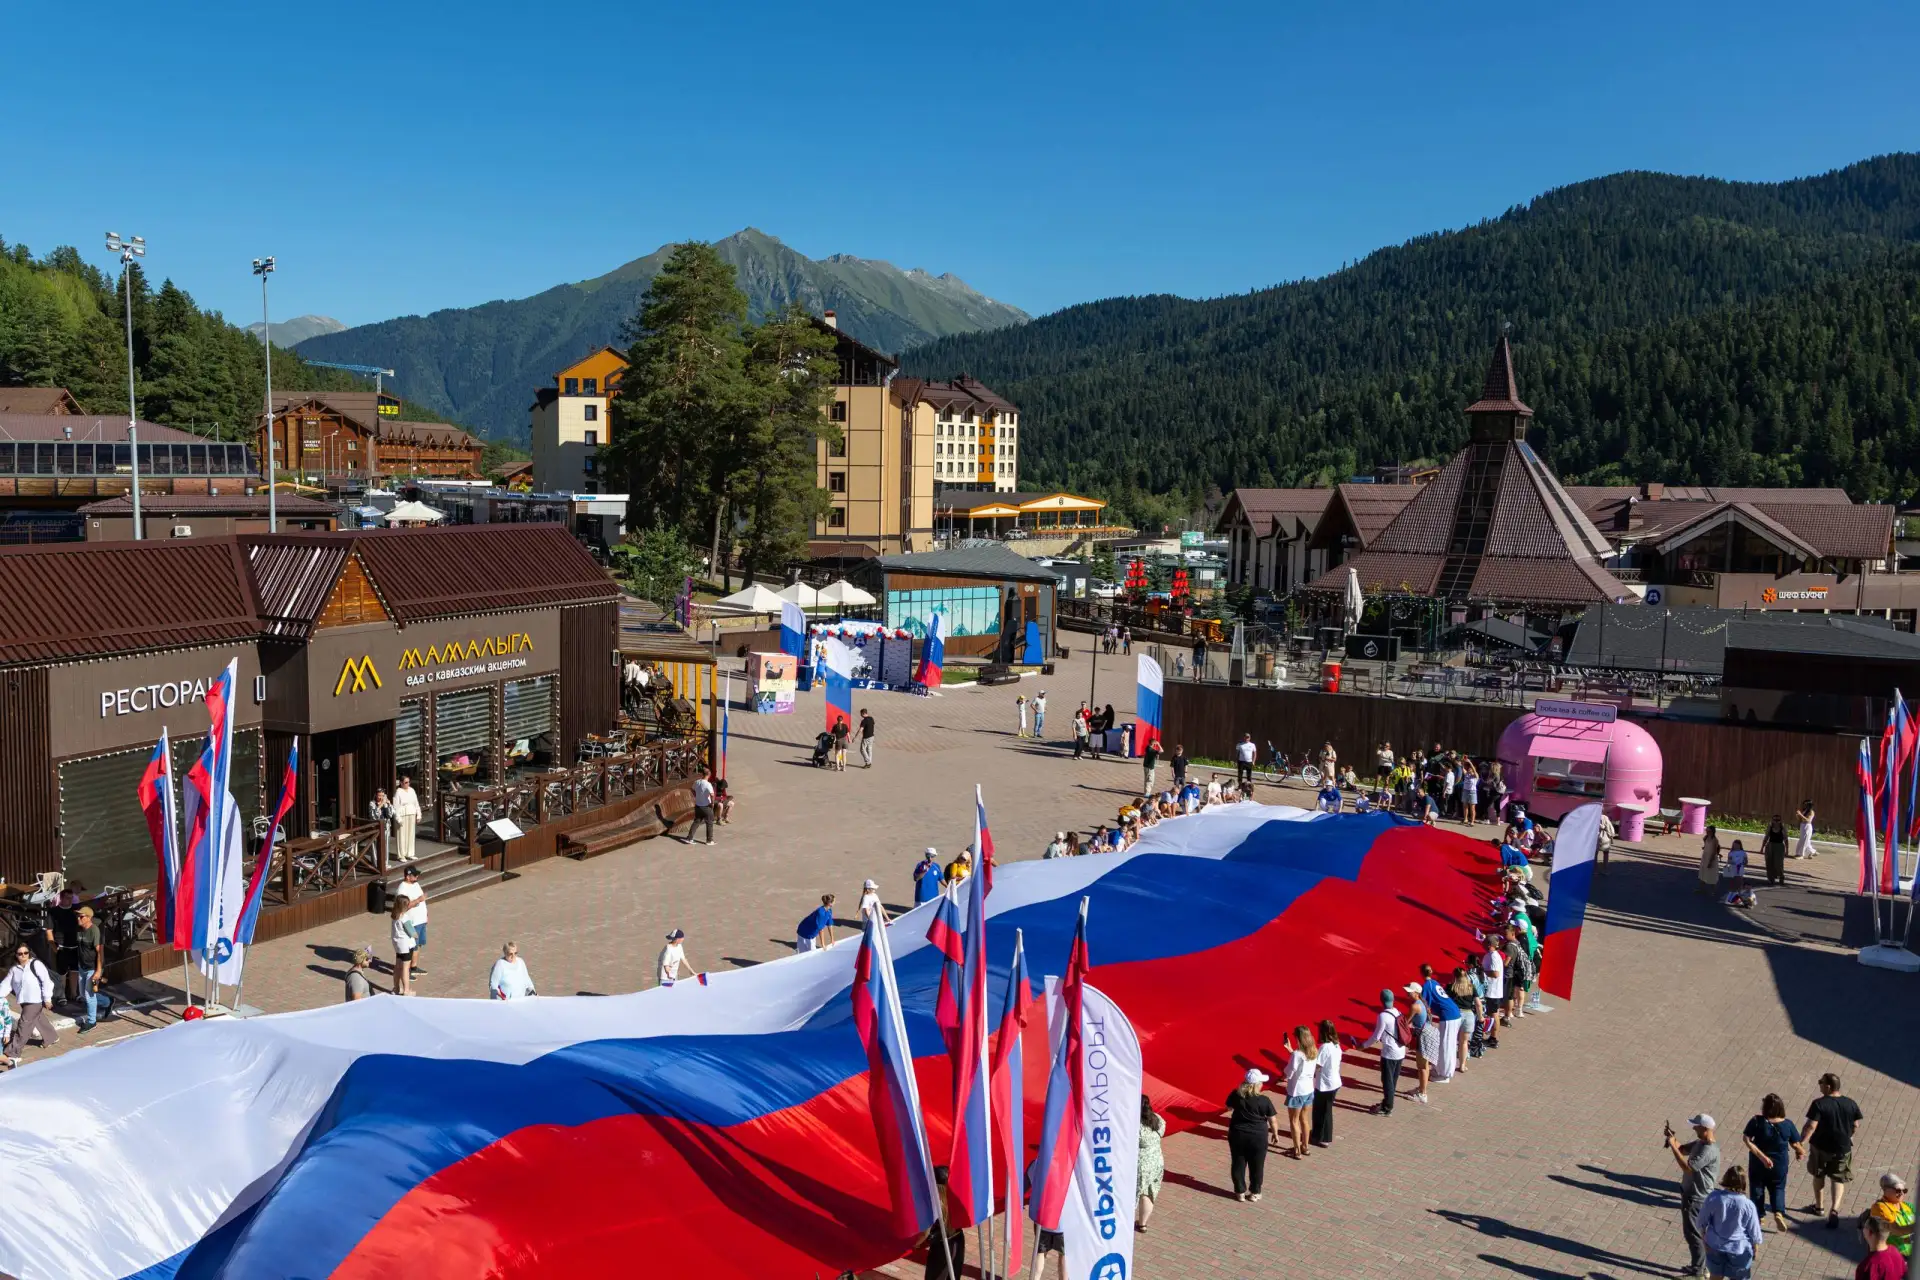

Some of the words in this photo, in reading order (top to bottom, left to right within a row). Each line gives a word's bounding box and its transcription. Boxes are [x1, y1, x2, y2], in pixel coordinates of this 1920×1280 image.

[399, 633, 533, 670] МАМАЛЫГА
[406, 674, 425, 686] еда
[427, 672, 434, 682] с
[436, 664, 486, 681] кавказским
[487, 657, 527, 672] акцентом
[1578, 709, 1601, 717] coffee
